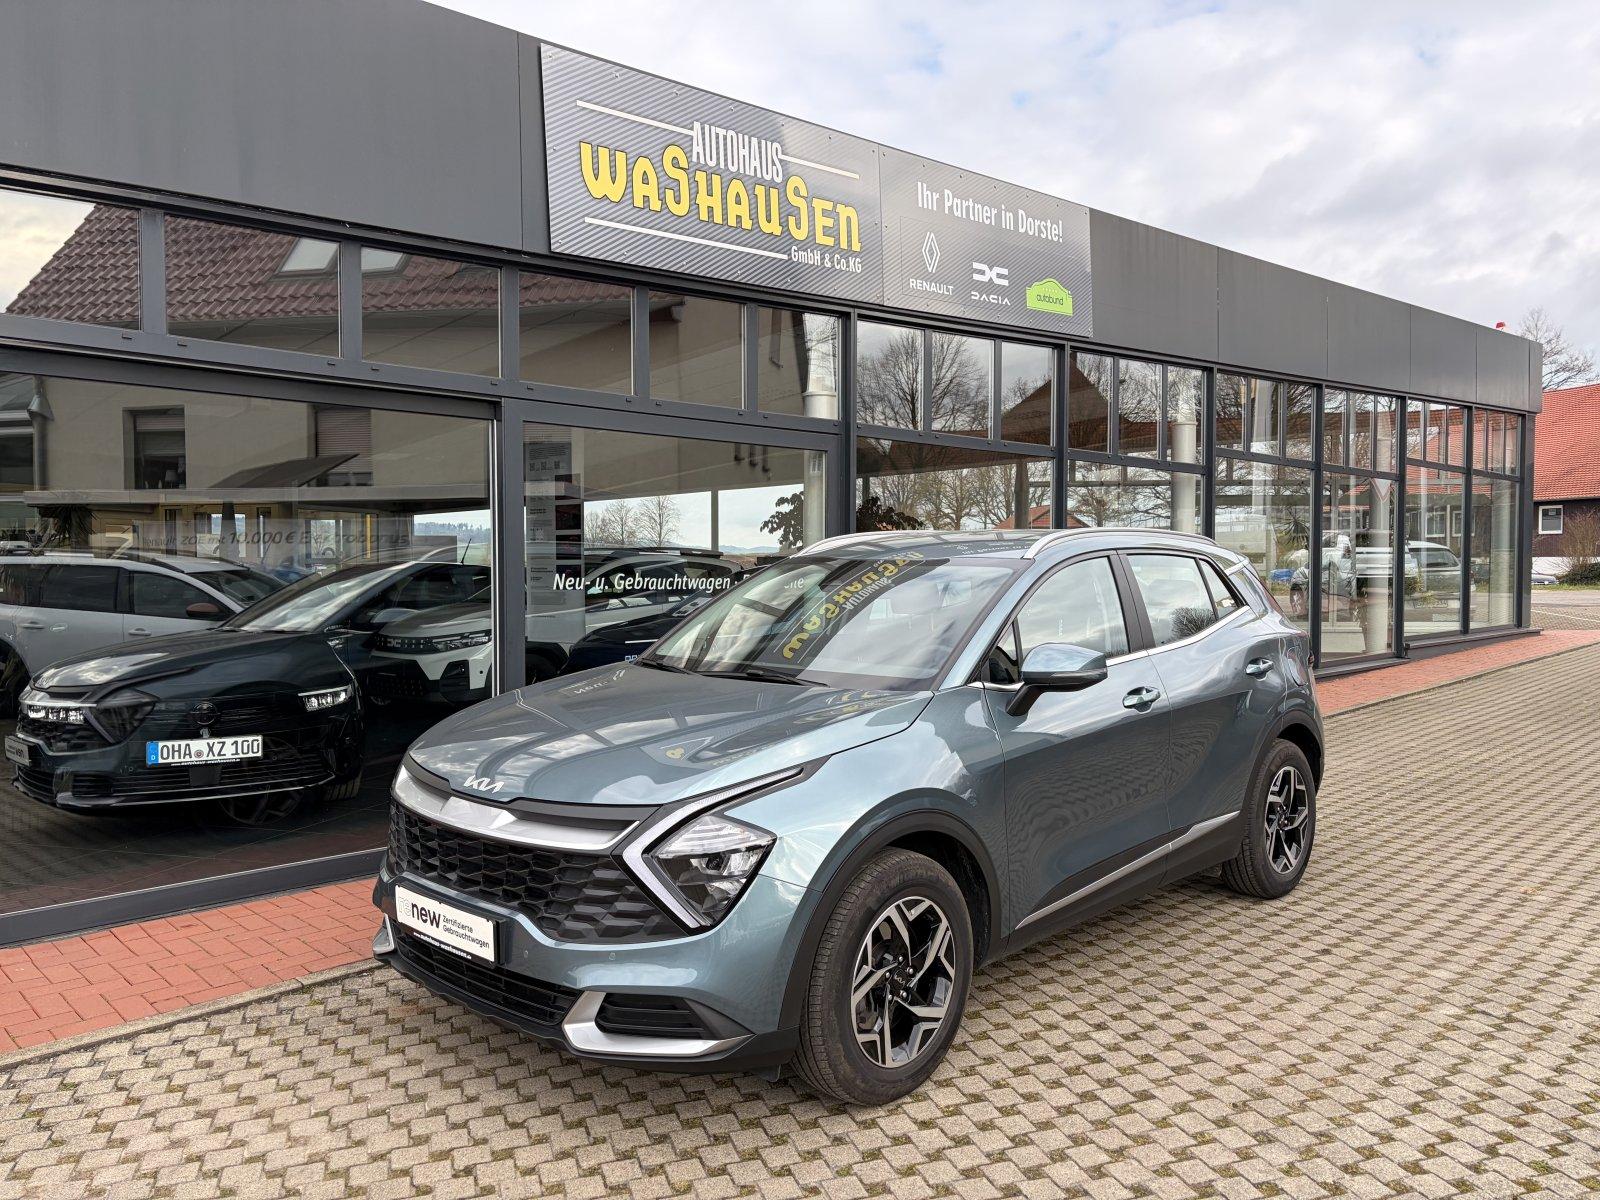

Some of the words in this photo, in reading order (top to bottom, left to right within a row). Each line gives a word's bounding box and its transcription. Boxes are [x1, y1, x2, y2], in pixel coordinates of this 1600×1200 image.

[692, 121, 783, 184] AUTOHAUS
[917, 181, 940, 212] Ihr
[944, 189, 998, 227] Partner
[1001, 205, 1014, 231] in
[1018, 209, 1063, 243] Dorste!
[790, 246, 821, 267] GmbH
[824, 254, 832, 268] &
[834, 255, 862, 273] Co.KG
[909, 278, 954, 296] RENAULT
[971, 291, 1011, 306] DACIA
[1035, 293, 1064, 306] autobund
[229, 531, 283, 545] 10.000
[553, 572, 593, 590] Neu-
[599, 576, 609, 590] u.
[614, 574, 731, 594] Gebrauchtwagen
[160, 743, 192, 760] OHA
[206, 741, 227, 758] XZ
[231, 739, 260, 756] 100
[464, 774, 505, 794] KIA
[442, 915, 474, 933] Zertifizierte
[442, 925, 490, 949] Gebrauchtwagen
